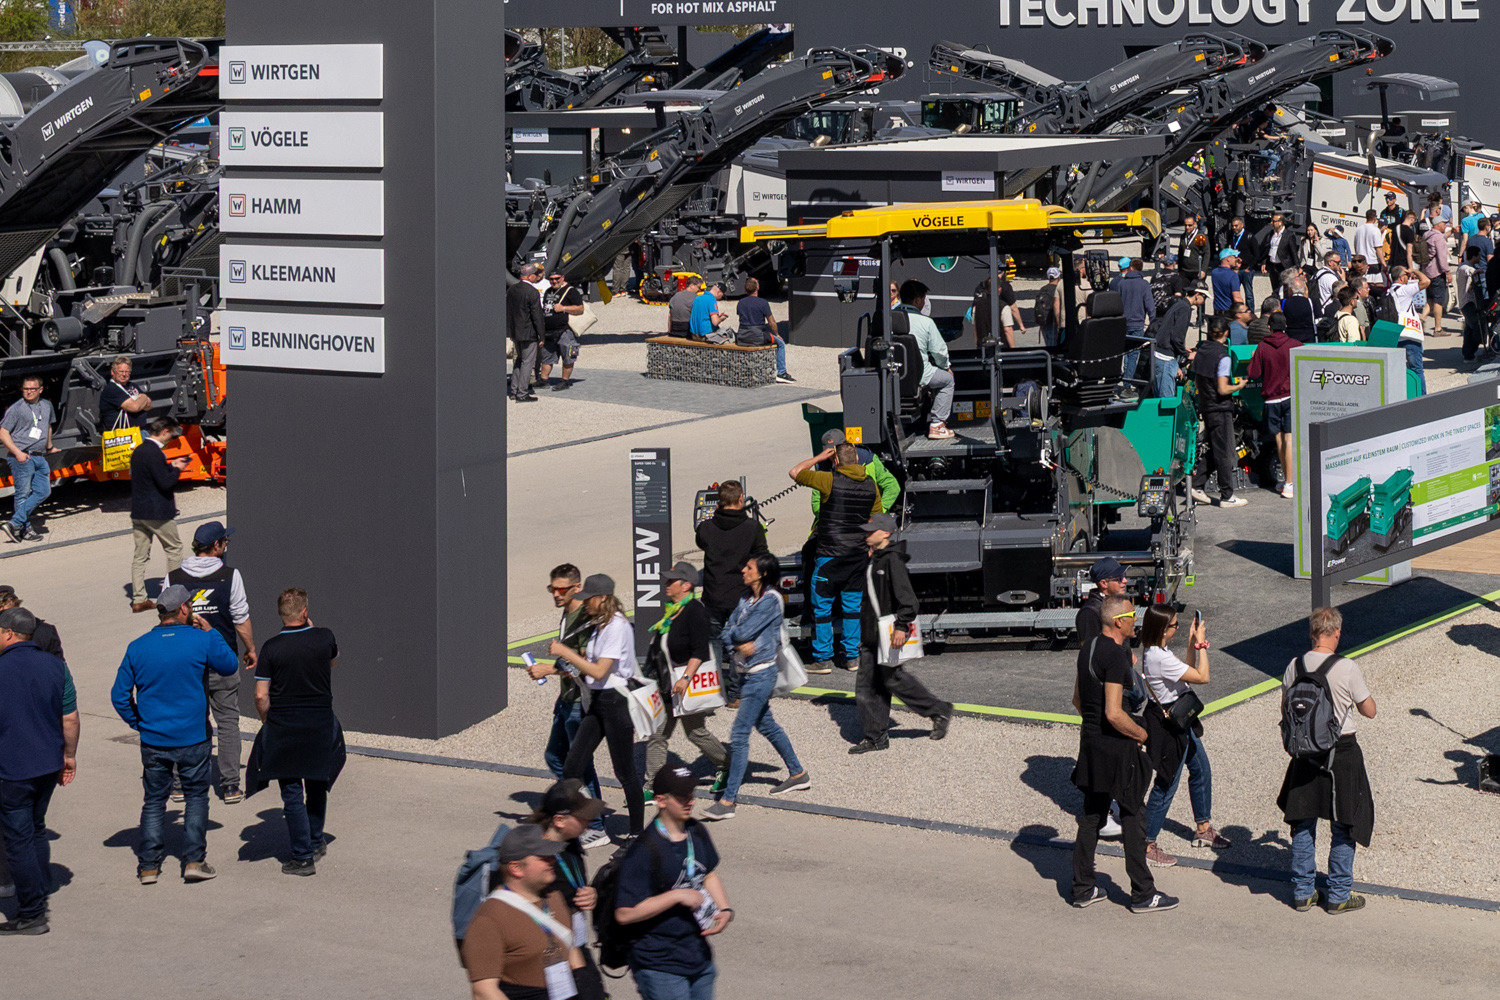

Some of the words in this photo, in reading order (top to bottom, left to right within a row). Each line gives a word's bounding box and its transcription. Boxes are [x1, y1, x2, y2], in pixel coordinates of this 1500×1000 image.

[651, 3, 673, 14] FOR
[676, 2, 699, 14] HOT
[703, 1, 724, 13] MIX
[727, 0, 776, 13] ASPHALT
[251, 63, 320, 80] WIRTGEN
[1255, 67, 1276, 81] WIRTGEN
[1117, 74, 1140, 89] WIRTGEN
[742, 94, 765, 110] WIRTGEN
[54, 96, 94, 130] WIRTGEN
[251, 126, 309, 147] VÖGELE
[252, 197, 301, 215] HAMM
[912, 215, 964, 228] VÖGELE
[1330, 217, 1358, 228] WIRTGEN
[251, 264, 336, 283] KLEEMANN
[1406, 317, 1421, 330] PERI
[251, 331, 375, 353] BENNINGHOVEN
[1325, 457, 1353, 470] MASSARBEIT
[1362, 448, 1386, 460] KLEINSTEM
[1386, 445, 1399, 453] RAUM
[1401, 437, 1427, 450] CUSTOMIZED
[1427, 433, 1440, 442] WORK
[1453, 426, 1467, 435] TINIEST
[1467, 421, 1481, 431] SPACES
[635, 526, 661, 608] NEW
